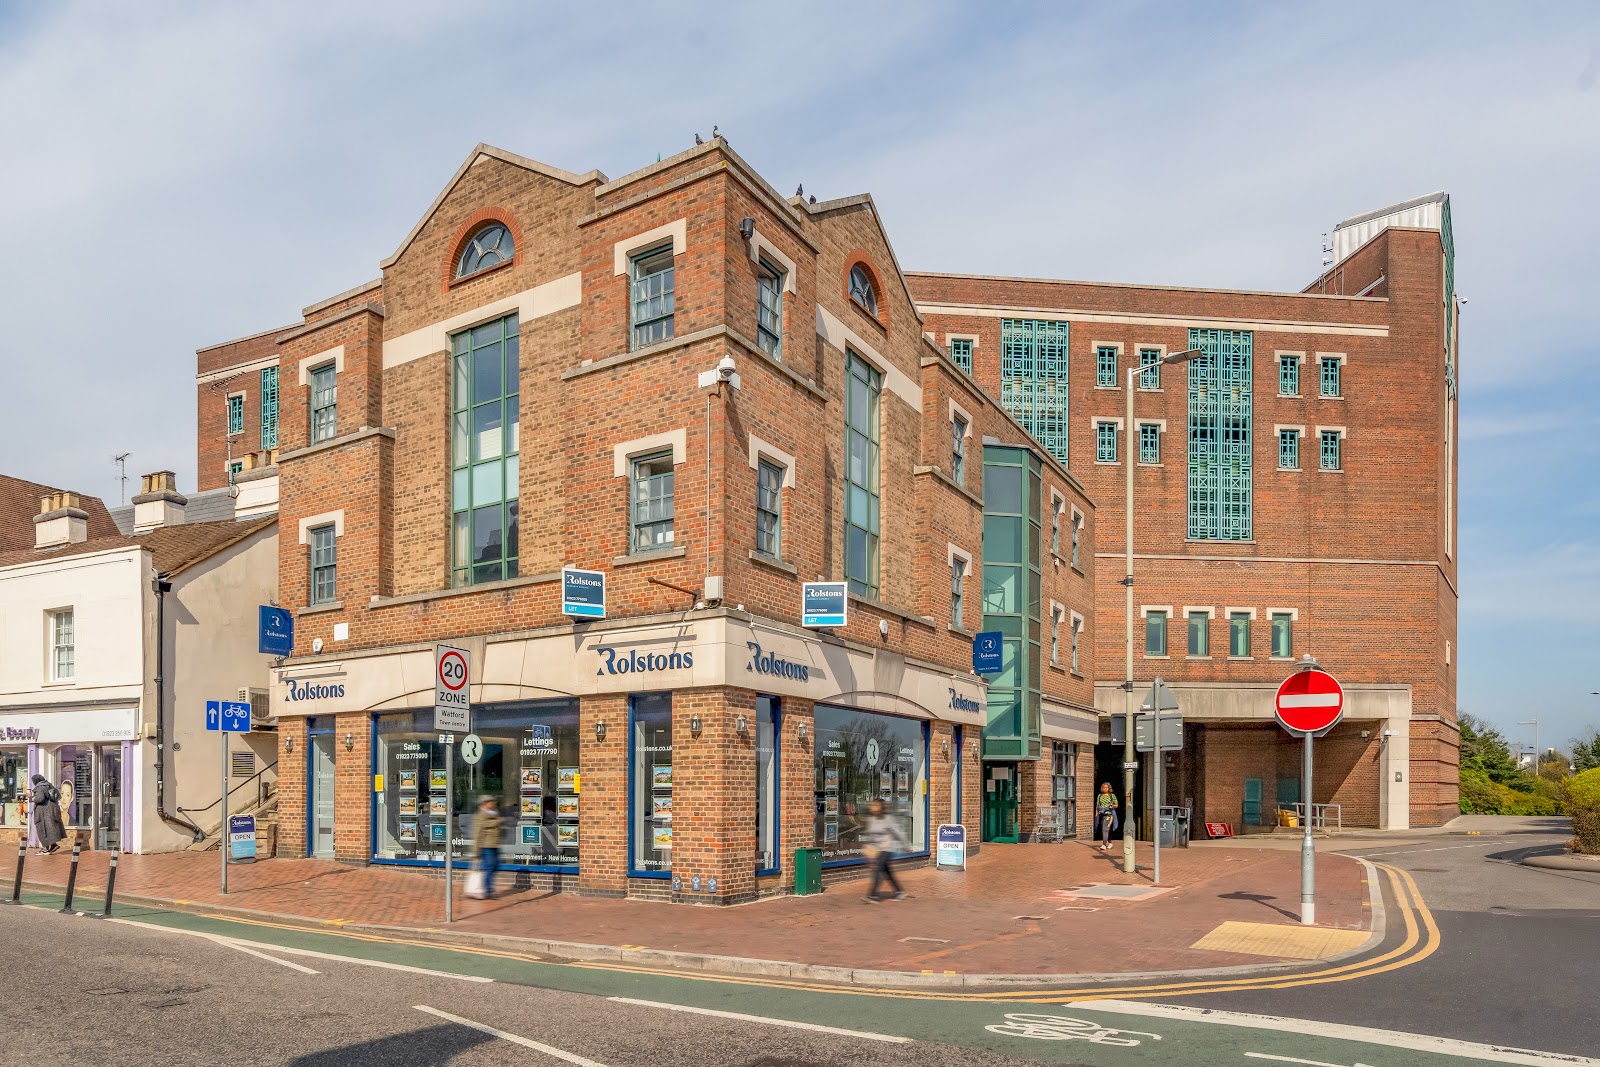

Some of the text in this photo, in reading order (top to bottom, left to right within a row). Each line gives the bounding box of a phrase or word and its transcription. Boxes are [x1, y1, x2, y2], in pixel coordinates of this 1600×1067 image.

[566, 574, 602, 587] Rolstons
[807, 588, 843, 598] Rolstons
[265, 629, 288, 638] Rolstons
[596, 647, 694, 676] Rolstons
[746, 641, 809, 682] Rolstons
[444, 661, 464, 680] 20
[284, 679, 345, 702] Rolstons
[439, 691, 467, 705] ZONE
[948, 687, 980, 714] Rolstons
[441, 710, 465, 719] Watford
[6, 726, 40, 742] Beauty
[403, 742, 421, 751] Sales
[523, 737, 554, 748] Lettings
[828, 739, 841, 749] Sales
[520, 748, 558, 756] 01923 777790
[415, 849, 433, 857] Property
